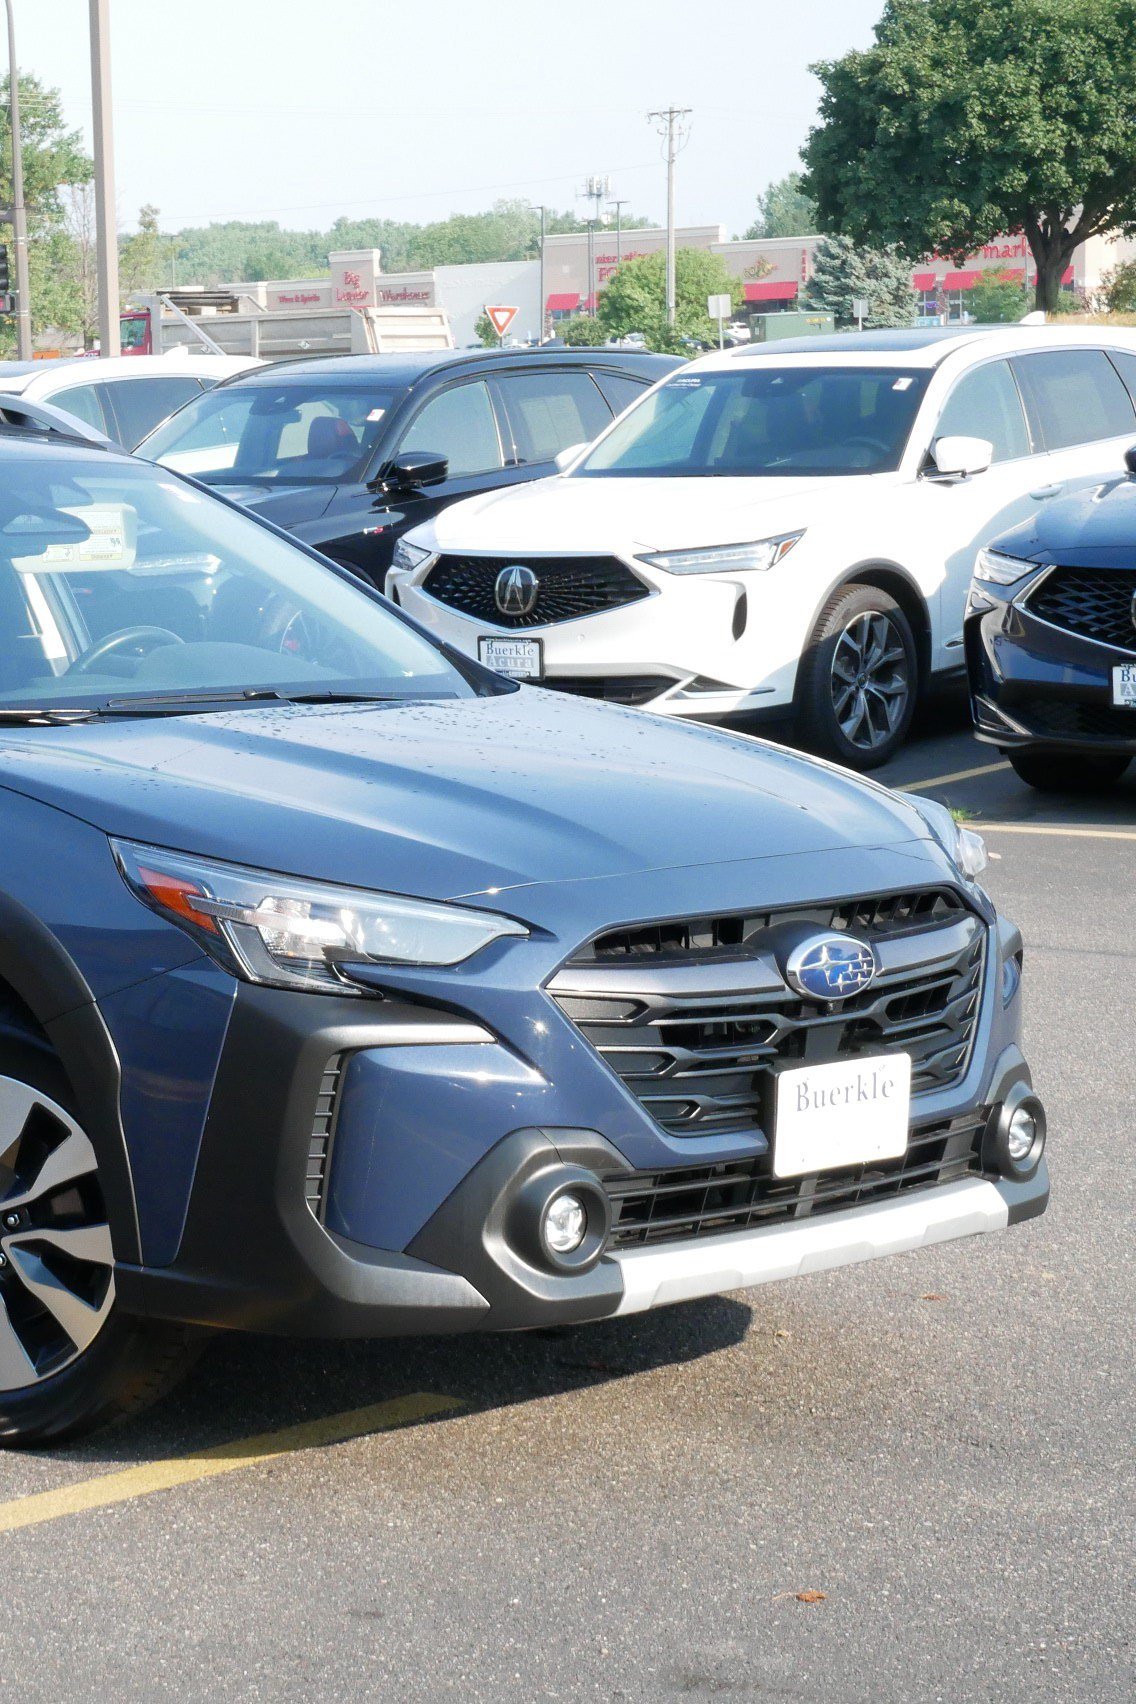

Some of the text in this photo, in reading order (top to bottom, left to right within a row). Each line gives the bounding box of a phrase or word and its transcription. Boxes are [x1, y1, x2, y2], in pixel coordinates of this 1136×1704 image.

[344, 271, 361, 289] Big
[336, 287, 370, 304] Liquor
[380, 286, 430, 302] Warehouse
[486, 643, 535, 656] Buerkle
[489, 655, 533, 668] Acura
[796, 1072, 894, 1112] Buerkle
